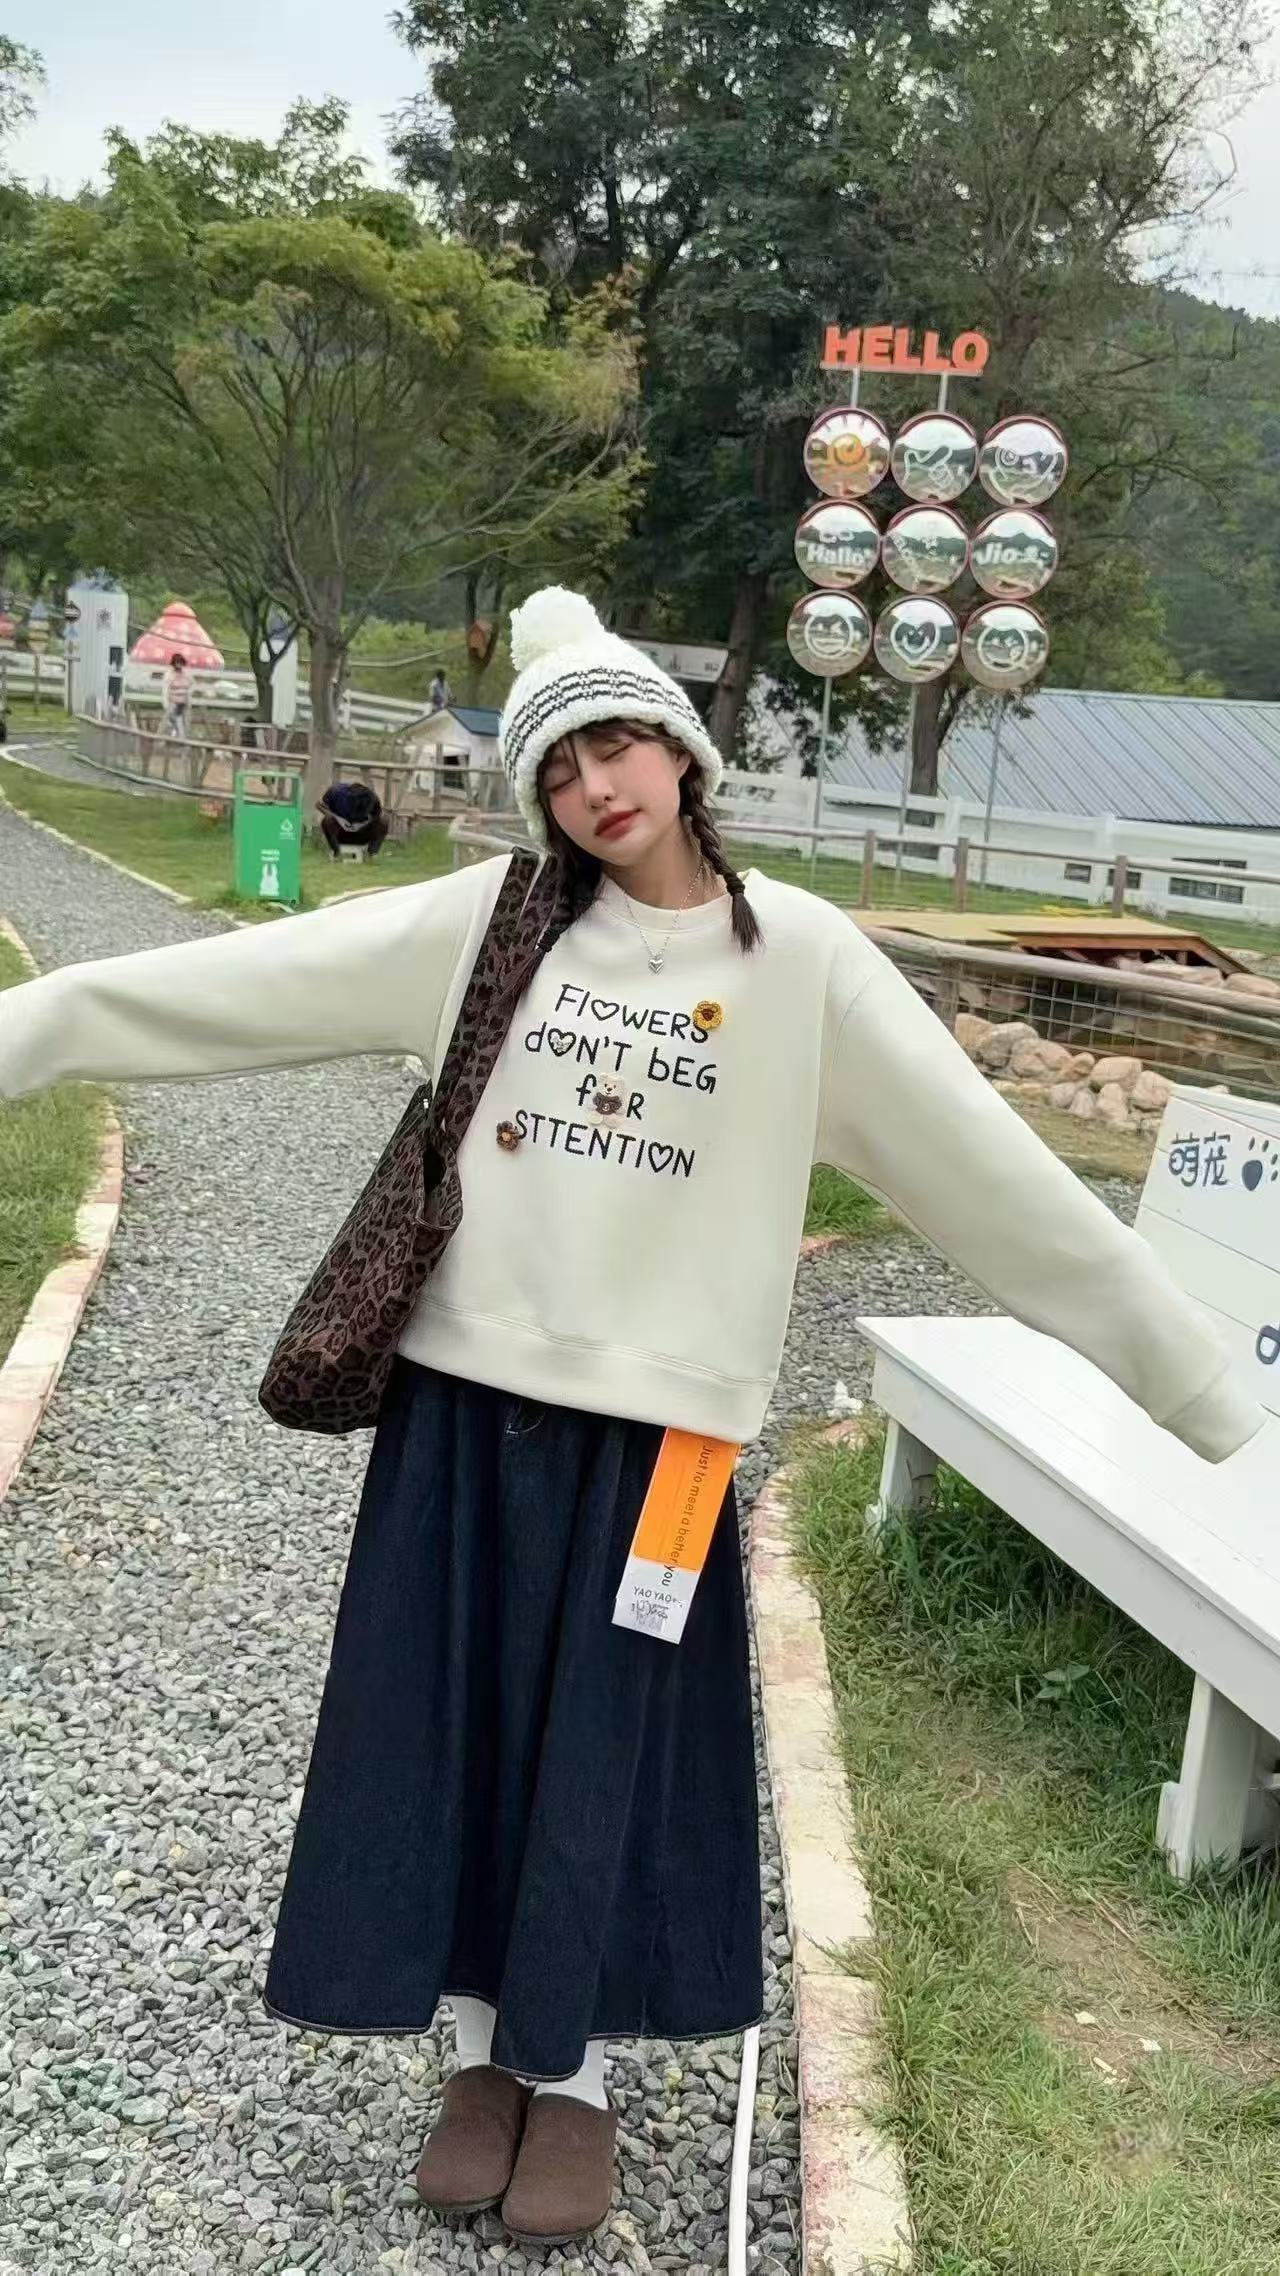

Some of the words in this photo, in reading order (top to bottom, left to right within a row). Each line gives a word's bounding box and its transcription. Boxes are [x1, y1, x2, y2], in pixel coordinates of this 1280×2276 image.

[824, 323, 989, 371] HELLO
[647, 1047, 717, 1094] bEG
[576, 1074, 645, 1120] fR
[698, 1444, 713, 1469] Just
[694, 1471, 706, 1483] to
[685, 1485, 700, 1517] meet
[680, 1518, 690, 1526] a
[670, 1528, 690, 1563] better
[662, 1565, 675, 1586] you
[634, 1586, 652, 1598] YAO
